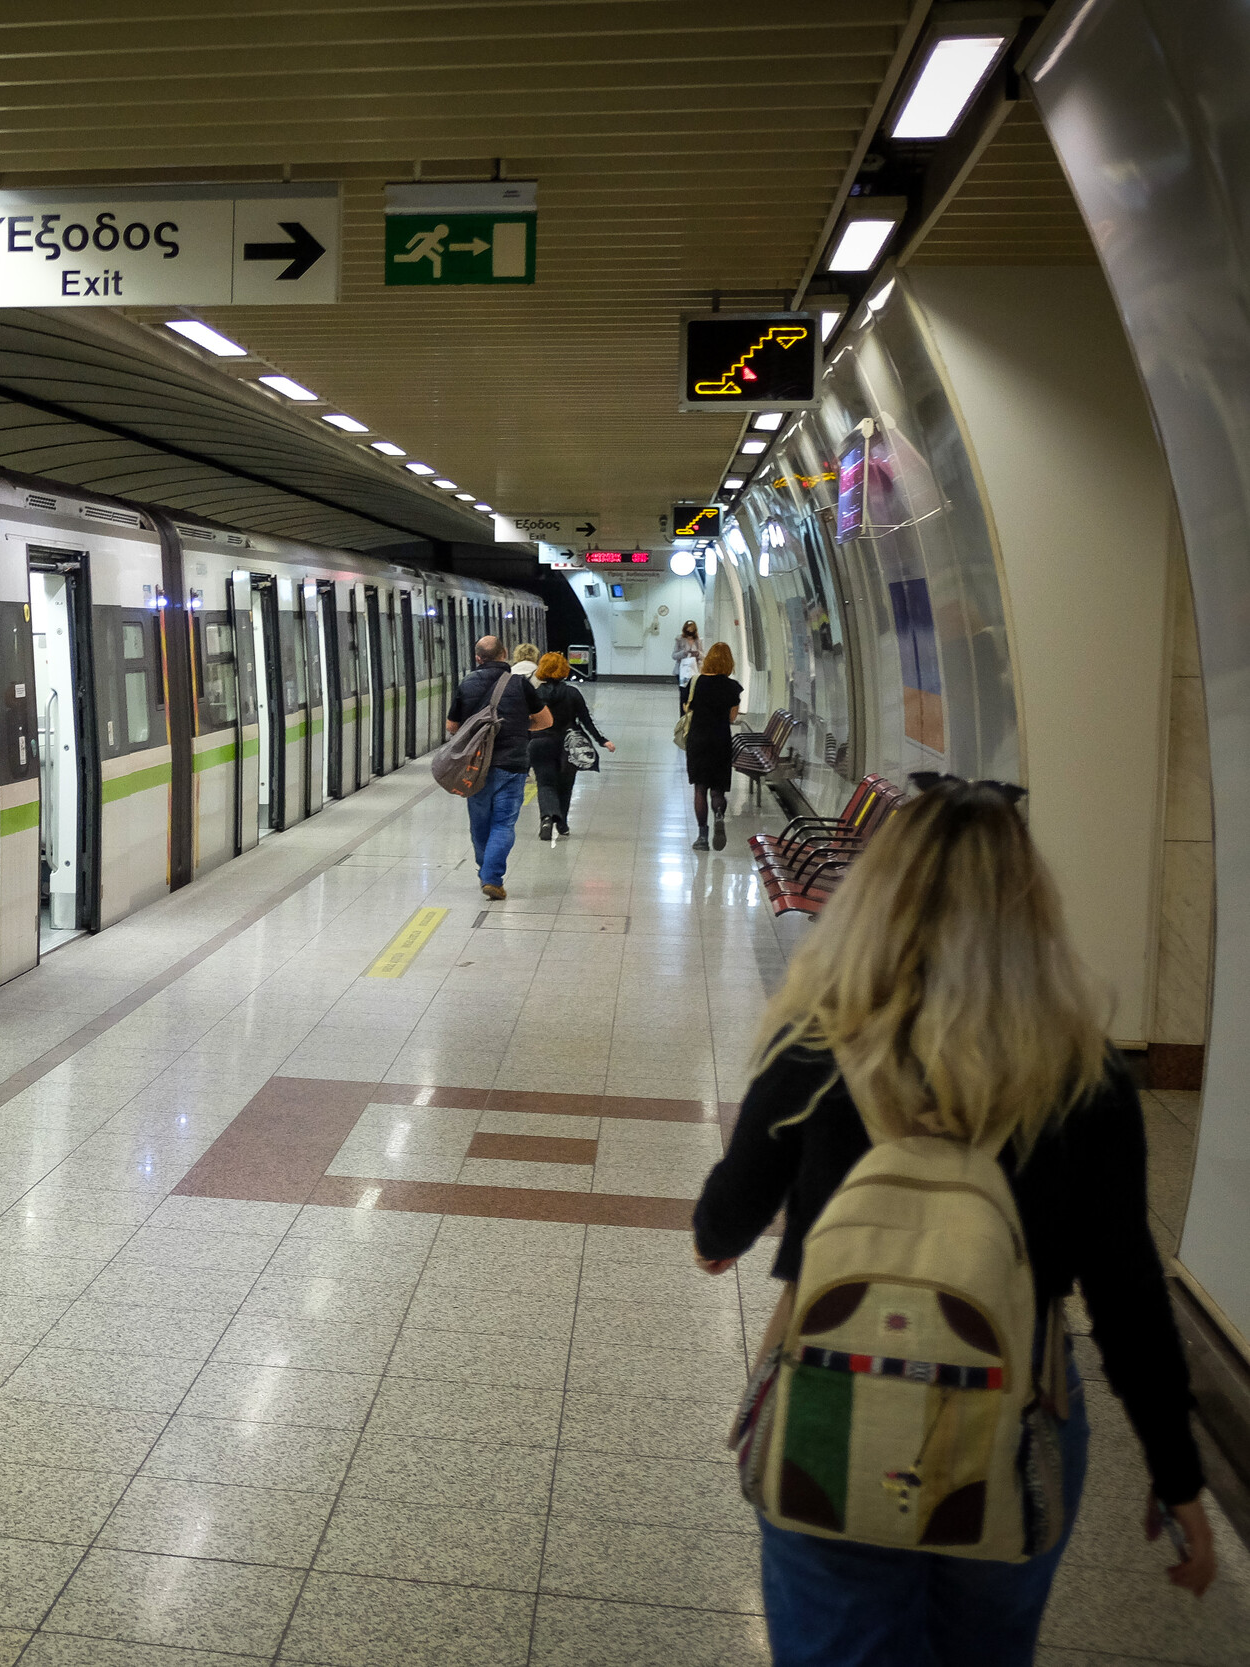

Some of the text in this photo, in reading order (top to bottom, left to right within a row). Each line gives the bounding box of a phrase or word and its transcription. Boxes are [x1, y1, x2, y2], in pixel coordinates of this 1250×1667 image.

[61, 270, 123, 297] Exit
[514, 519, 560, 532] Έξοδος
[529, 533, 546, 541] Exit
